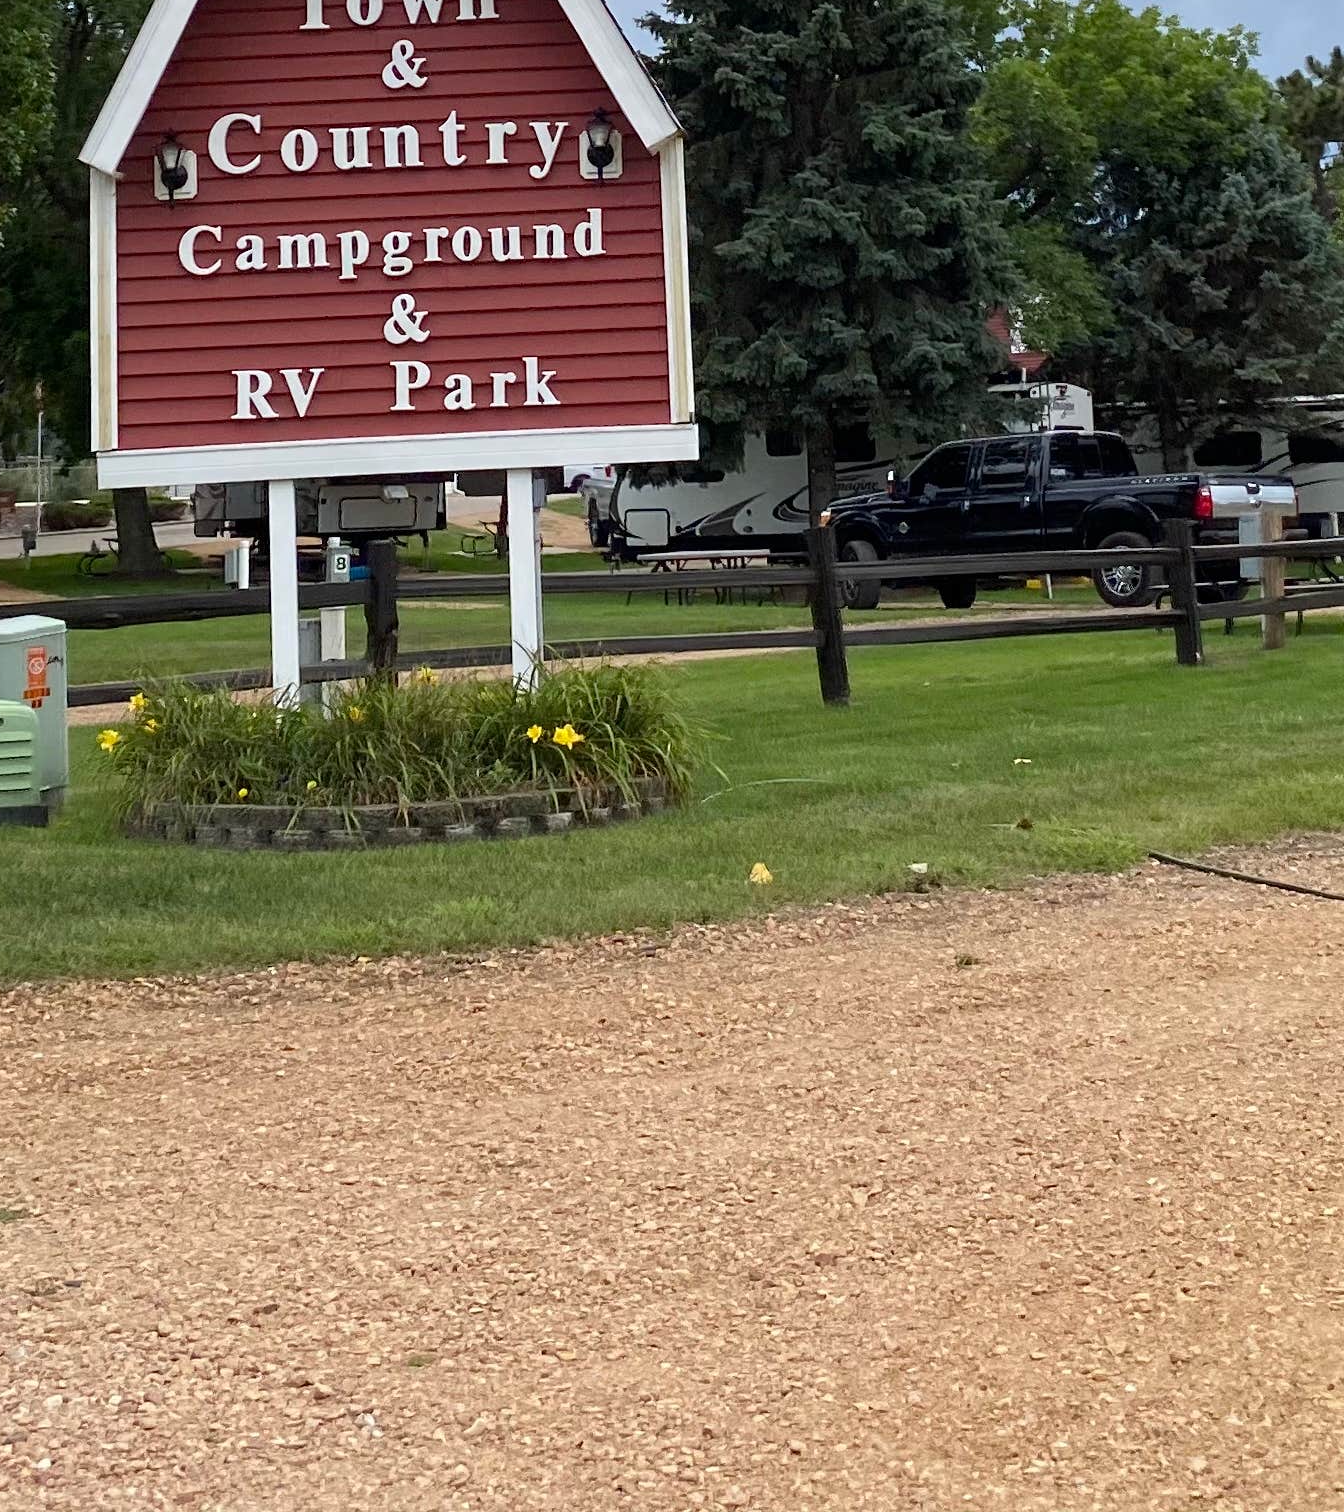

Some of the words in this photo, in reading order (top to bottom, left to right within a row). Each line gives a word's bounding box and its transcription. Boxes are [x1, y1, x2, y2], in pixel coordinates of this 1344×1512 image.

[381, 39, 428, 89] &
[207, 110, 568, 178] Country
[178, 208, 606, 279] Campground
[383, 293, 430, 345] &
[231, 368, 325, 420] RV
[389, 357, 561, 411] Park
